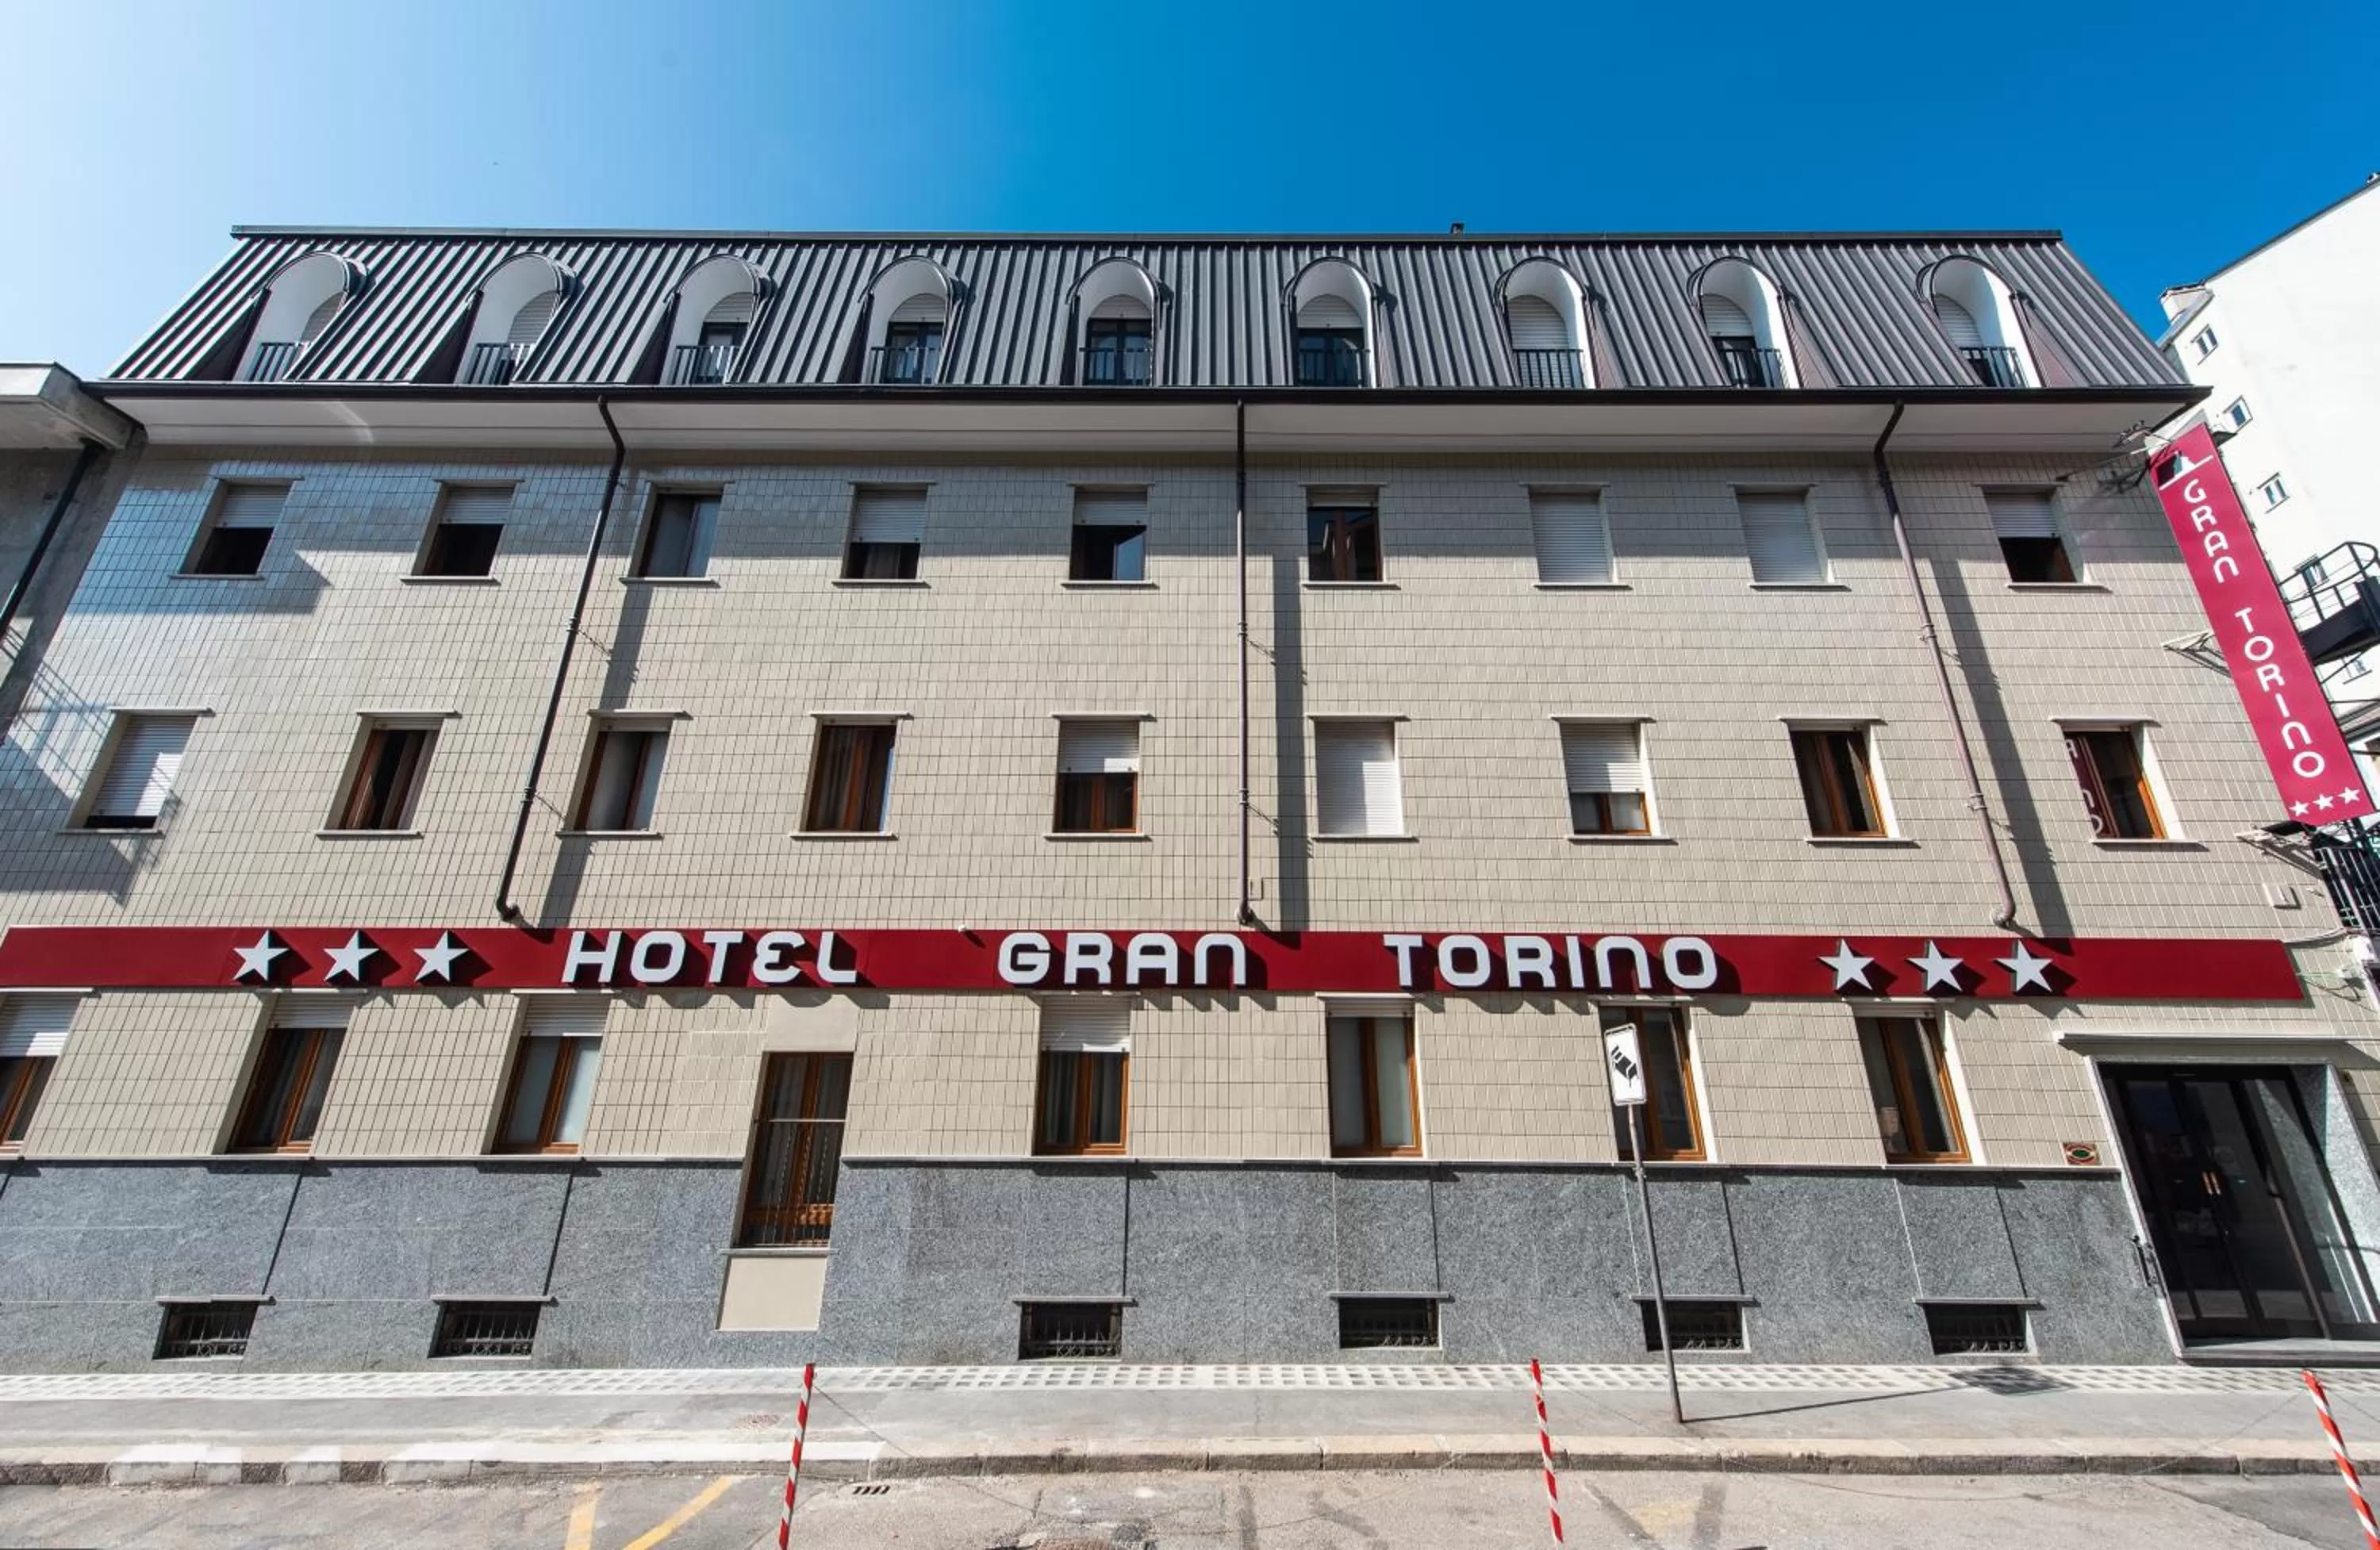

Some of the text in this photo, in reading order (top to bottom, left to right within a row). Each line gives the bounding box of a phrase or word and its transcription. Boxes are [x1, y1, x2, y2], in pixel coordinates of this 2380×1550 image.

[2183, 478, 2325, 778] GRAN TORINO
[561, 930, 1718, 990] HOTEL GRAN TORINO
